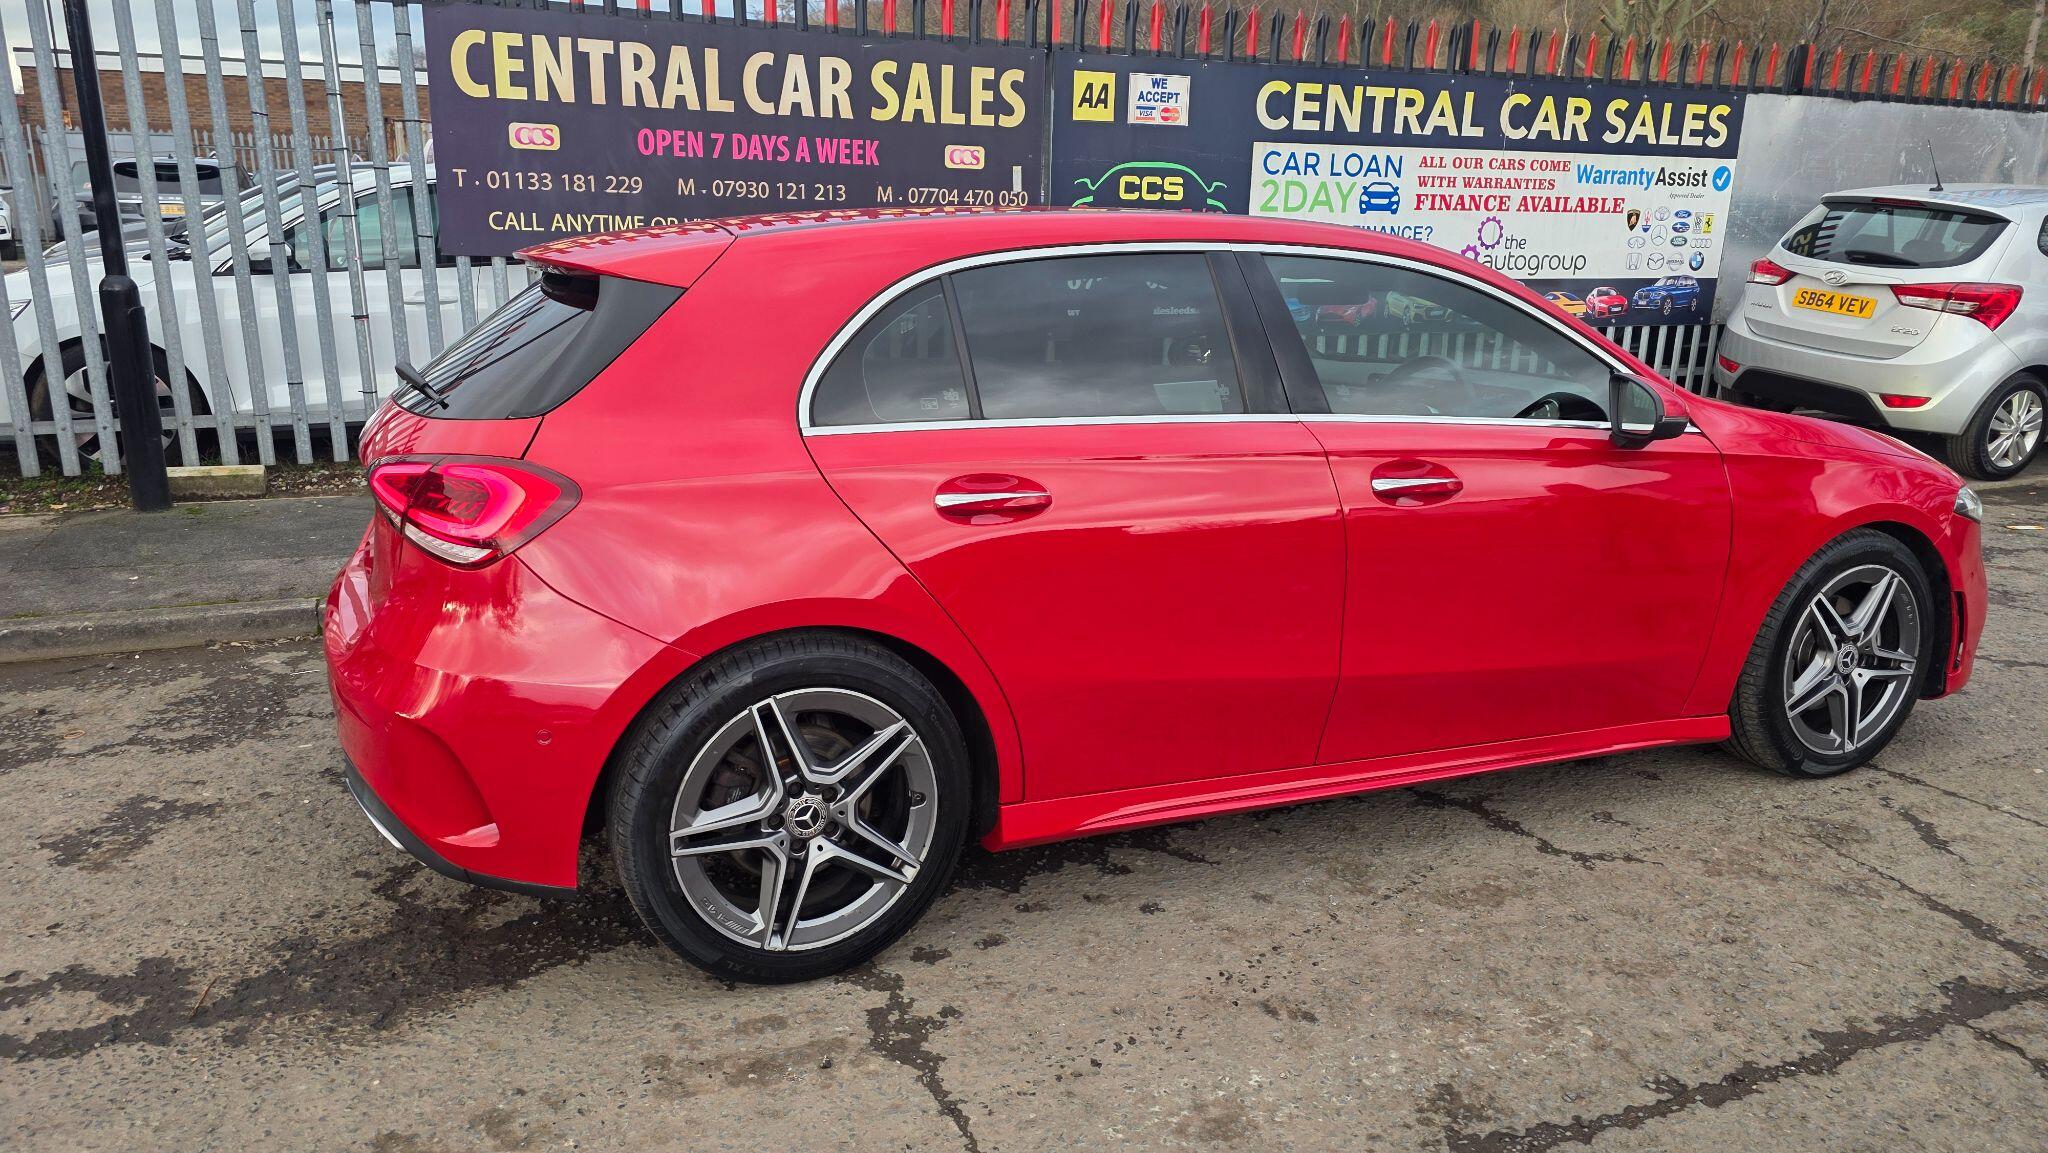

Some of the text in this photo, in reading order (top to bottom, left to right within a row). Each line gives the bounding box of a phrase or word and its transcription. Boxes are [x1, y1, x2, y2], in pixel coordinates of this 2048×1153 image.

[450, 29, 1026, 128] CENTRAL CAR SALES
[1151, 78, 1168, 90] WE
[1078, 82, 1109, 109] AA
[1137, 91, 1180, 104] ACCEPT
[1256, 80, 1732, 148] CENTRAL CAR SALES
[637, 128, 880, 166] OPEN 7 DAYS A WEEK
[1263, 150, 1403, 178] CAR LOAN
[1418, 156, 1571, 172] ALL OUR CARS COME
[486, 170, 553, 191] 01133
[561, 173, 595, 193] 181
[604, 175, 643, 195] 229
[712, 179, 769, 199] 07930
[776, 182, 806, 200] 121
[814, 183, 846, 202] 213
[1119, 175, 1184, 201] CCS
[1417, 175, 1556, 191] WITH WARRANTIES
[908, 187, 959, 205] 07704
[963, 189, 993, 205] 470
[999, 190, 1028, 207] 050
[1259, 179, 1358, 213] 2DAY
[1414, 193, 1625, 214] FINANCE AVAILABLE
[488, 211, 544, 232] CALL
[551, 213, 644, 233] ANYTIME
[1504, 234, 1527, 250] the
[1482, 251, 1587, 276] autogroup
[1798, 290, 1870, 314] SB64 VEV
